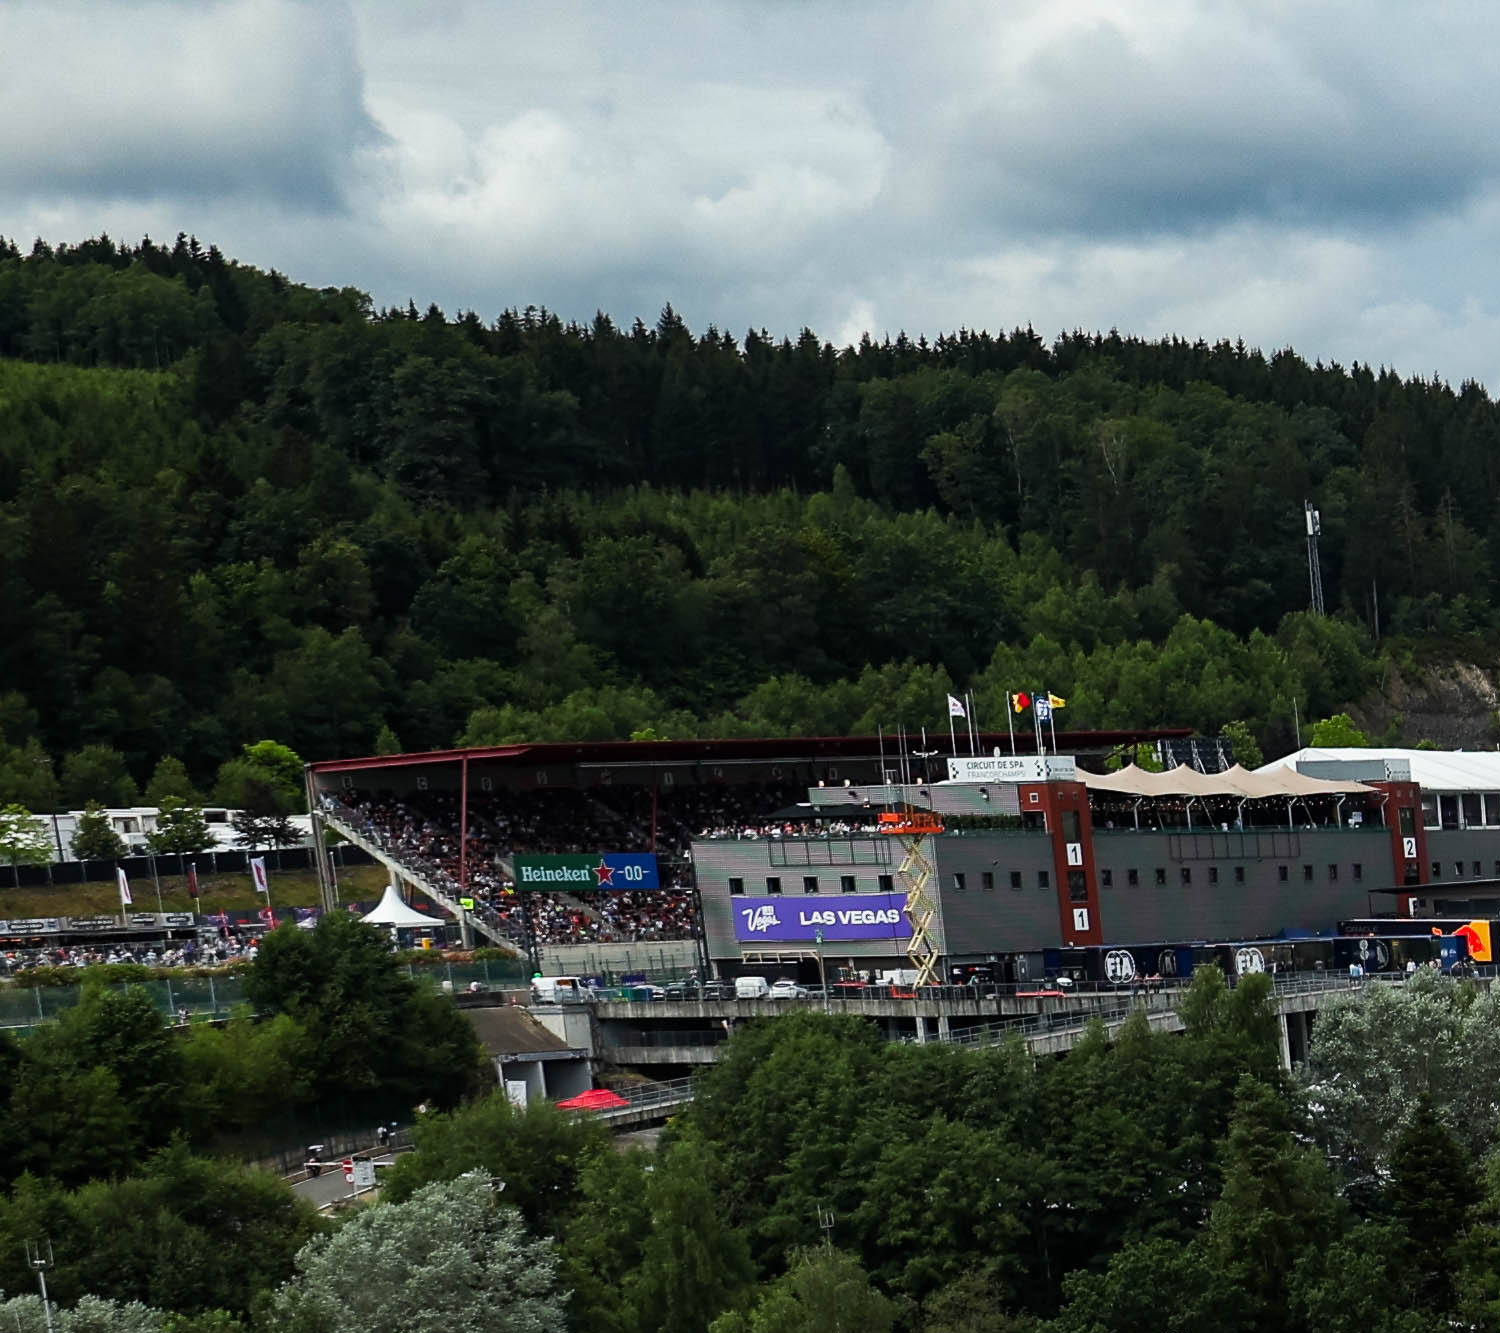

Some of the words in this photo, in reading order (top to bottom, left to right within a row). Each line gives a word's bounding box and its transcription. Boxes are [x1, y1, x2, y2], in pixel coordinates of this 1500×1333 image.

[966, 761, 995, 770] CIRCUIT
[997, 761, 1008, 769] DE
[1010, 761, 1024, 769] SPA
[1070, 846, 1078, 864] 1
[1406, 840, 1414, 856] 2
[522, 866, 590, 882] Heineken
[800, 911, 836, 926] LAS
[839, 908, 900, 925] VEGAS
[1077, 911, 1085, 929] 1
